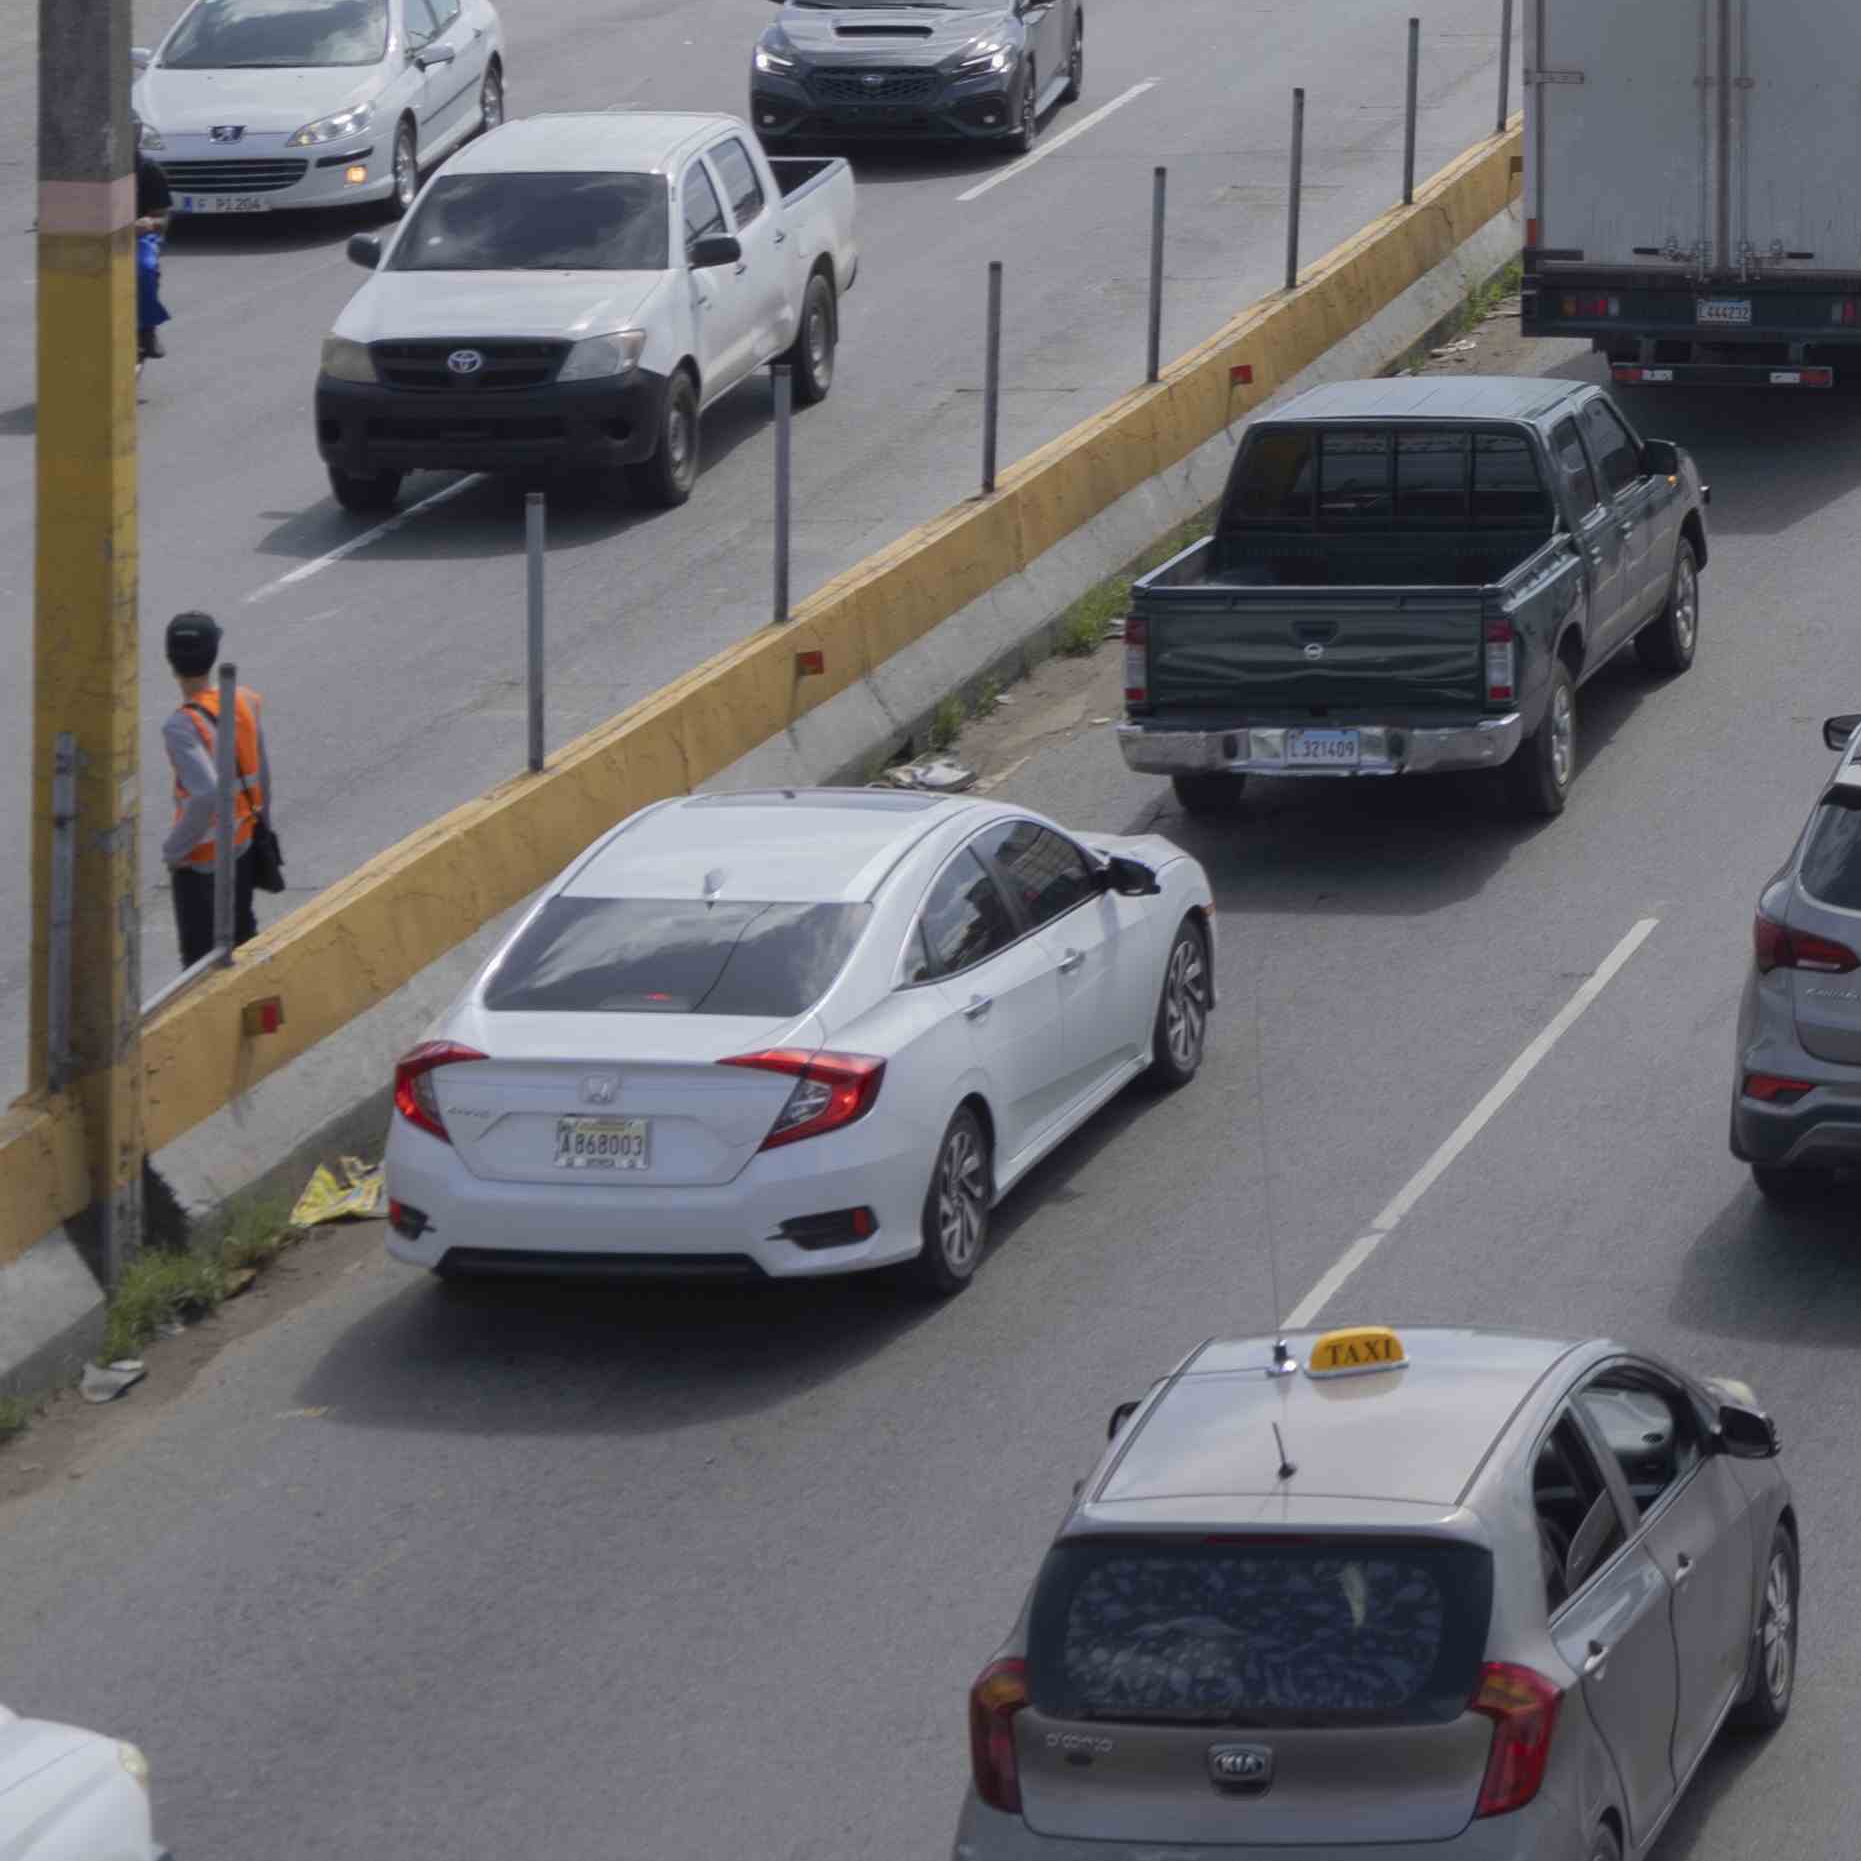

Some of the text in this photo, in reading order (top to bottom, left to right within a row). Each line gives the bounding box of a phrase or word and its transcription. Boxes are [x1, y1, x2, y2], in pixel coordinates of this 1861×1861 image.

[560, 1132, 643, 1156] A868003
[1325, 1339, 1393, 1367] TAXI
[1214, 1753, 1265, 1773] KIA
